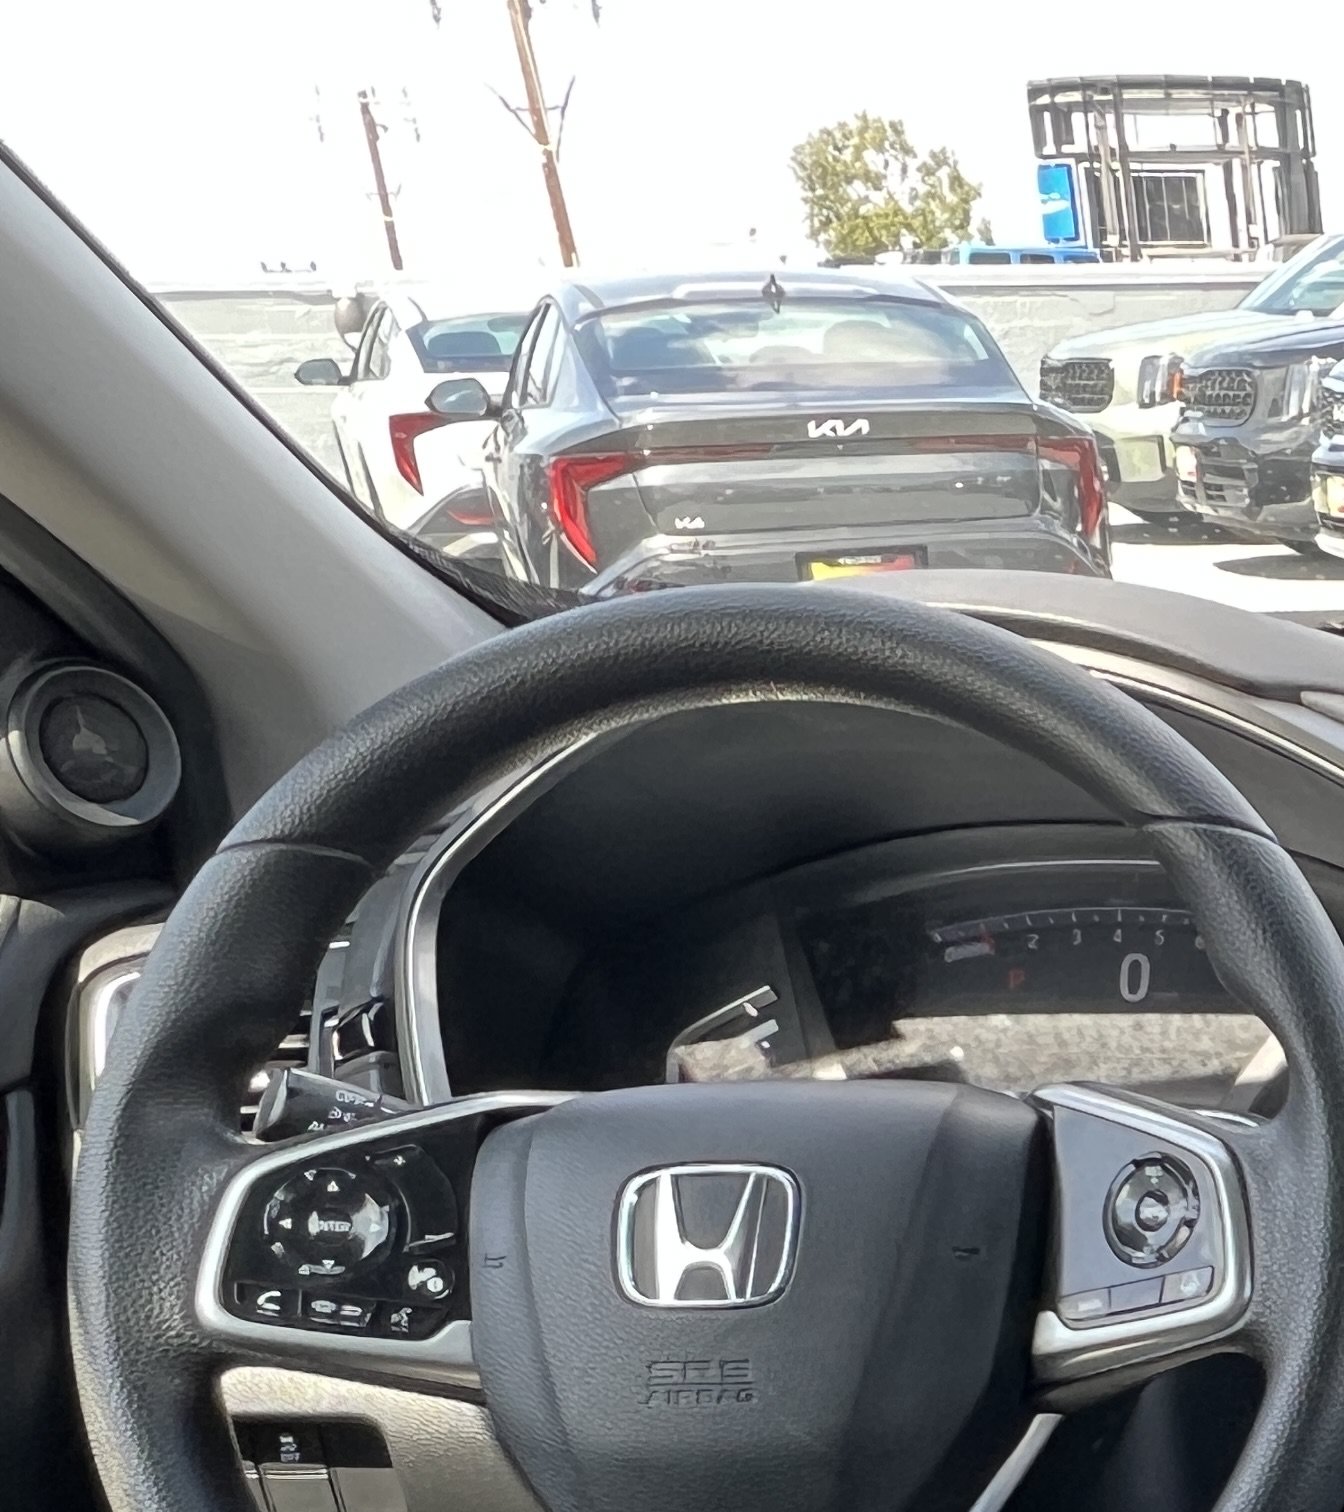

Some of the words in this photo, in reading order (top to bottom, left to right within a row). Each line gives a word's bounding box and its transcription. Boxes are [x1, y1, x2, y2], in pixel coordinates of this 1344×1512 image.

[808, 418, 871, 438] KIA
[1027, 933, 1040, 950] 2
[1072, 928, 1082, 946] 3
[1119, 952, 1151, 1002] 0
